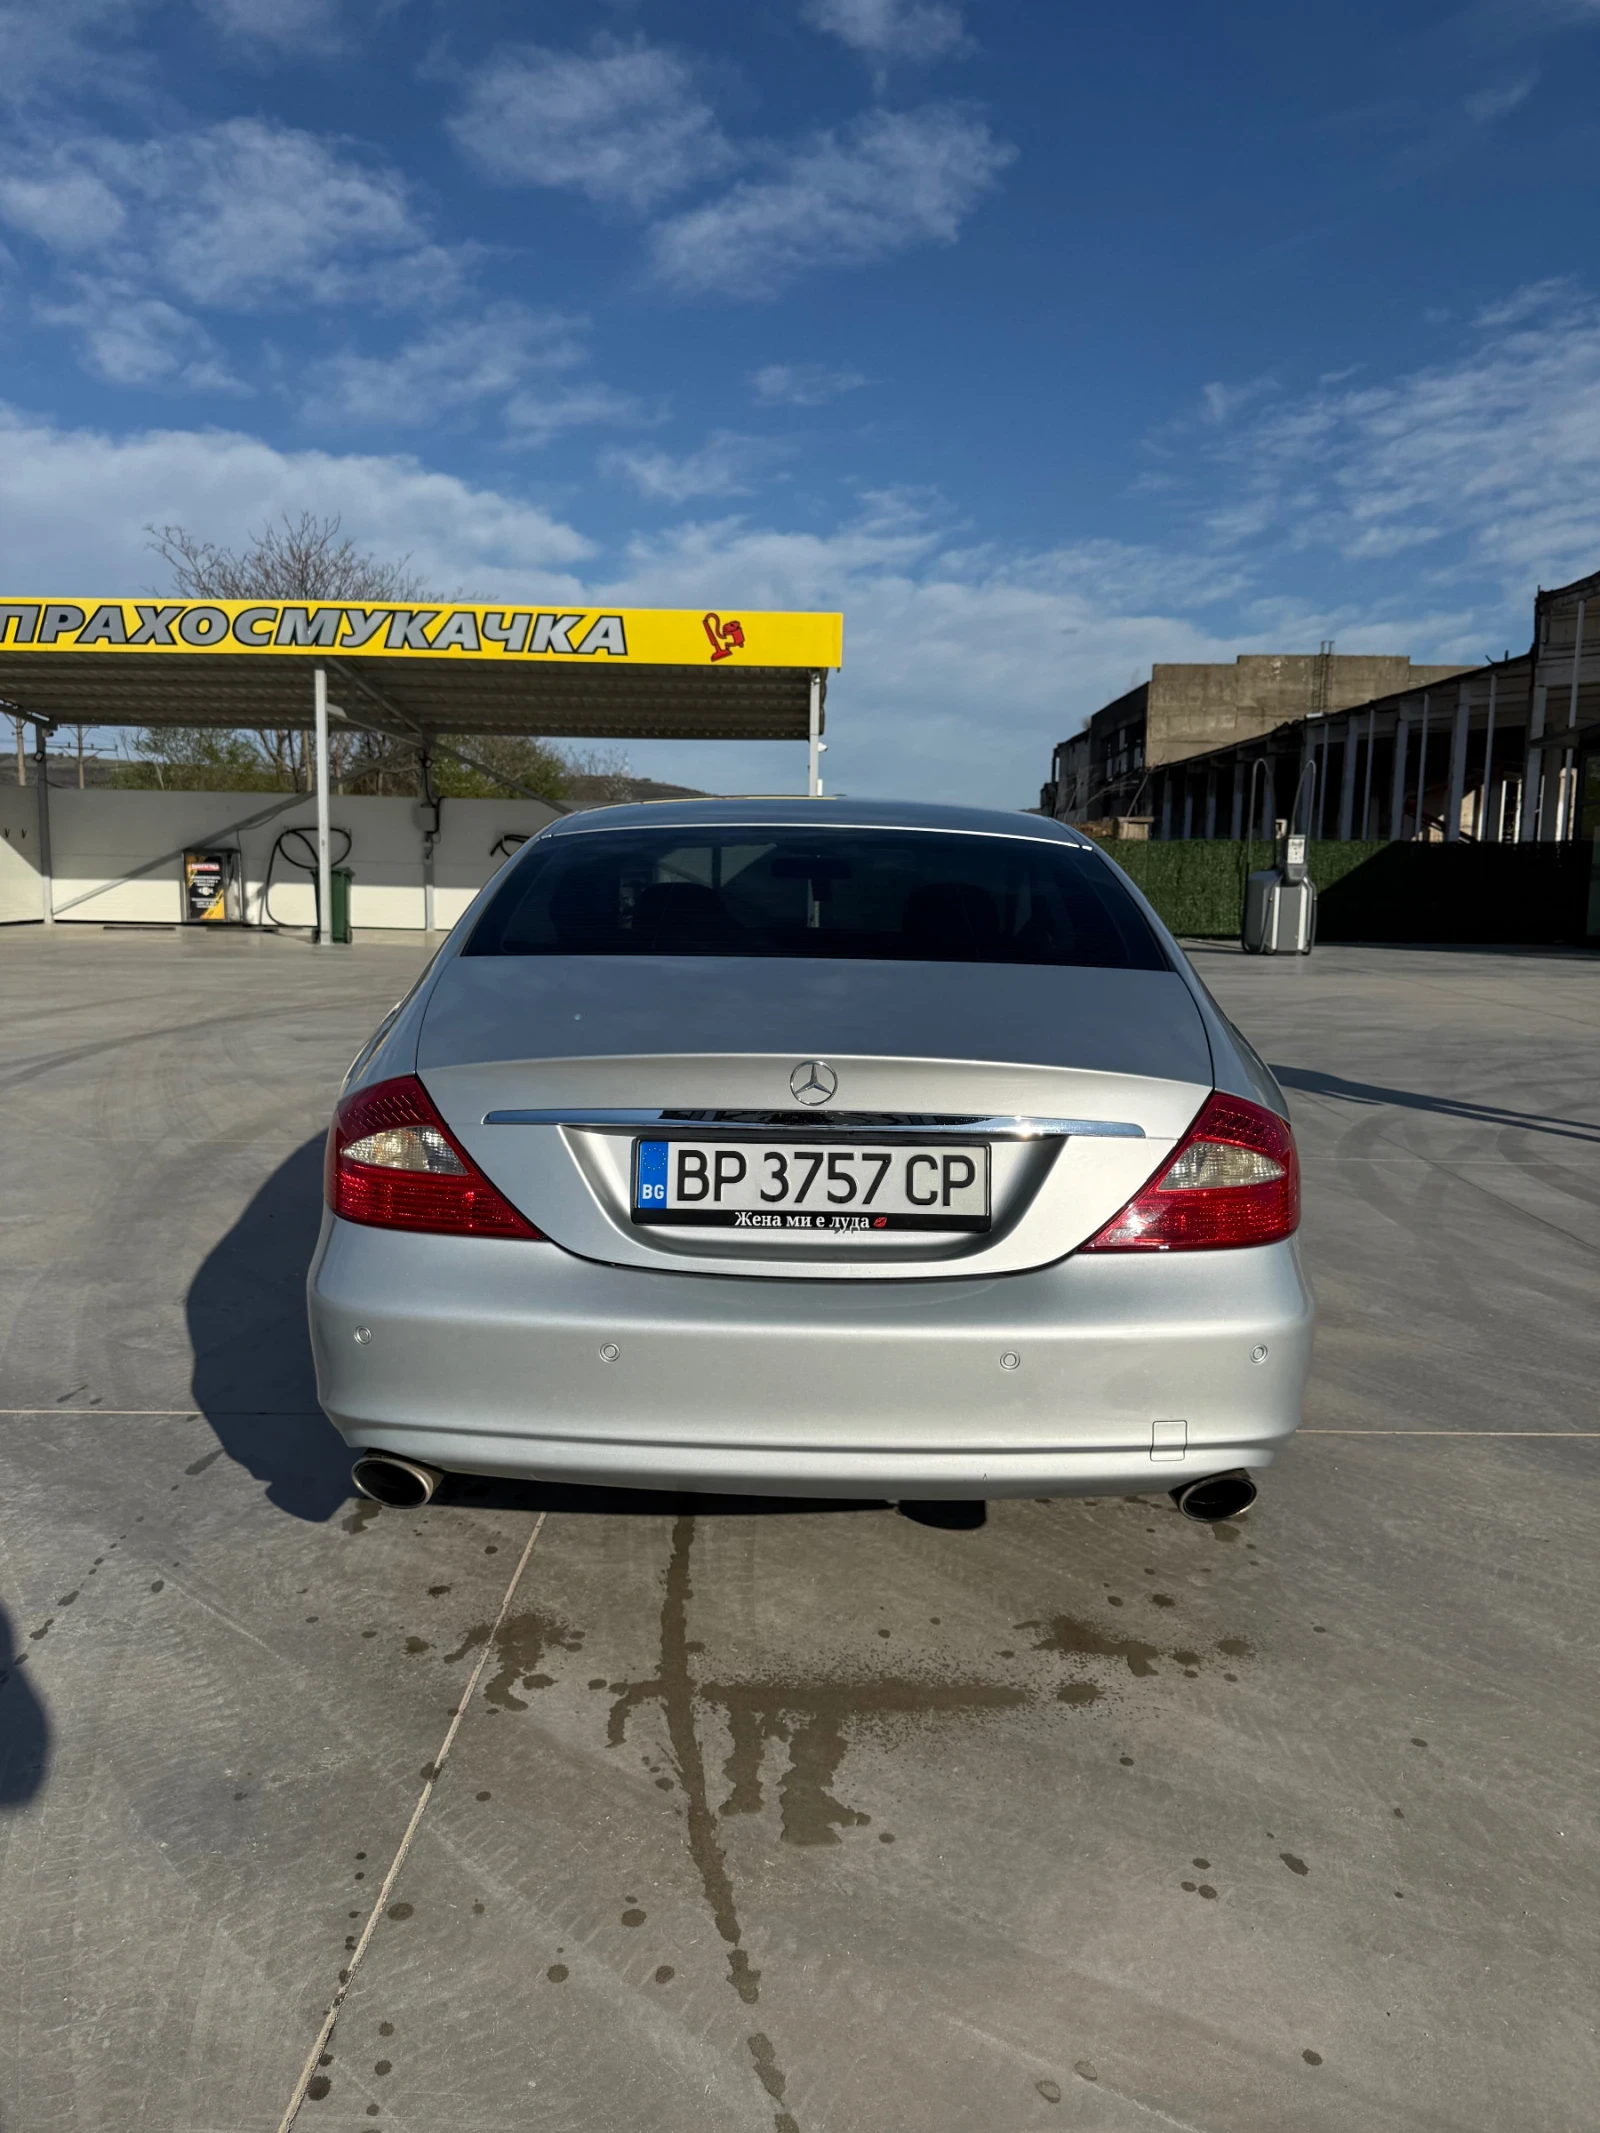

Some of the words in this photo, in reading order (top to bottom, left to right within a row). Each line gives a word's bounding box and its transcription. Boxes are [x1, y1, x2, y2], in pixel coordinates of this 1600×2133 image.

[0, 604, 628, 656] ПРАХОСМУКАЧКА
[642, 1184, 665, 1200] BG
[677, 1149, 747, 1202] BP
[760, 1151, 892, 1205] 3757
[905, 1154, 976, 1207] CP
[734, 1211, 782, 1227] Жена
[786, 1215, 812, 1228] ми
[816, 1216, 825, 1228] е
[829, 1217, 870, 1234] луда
